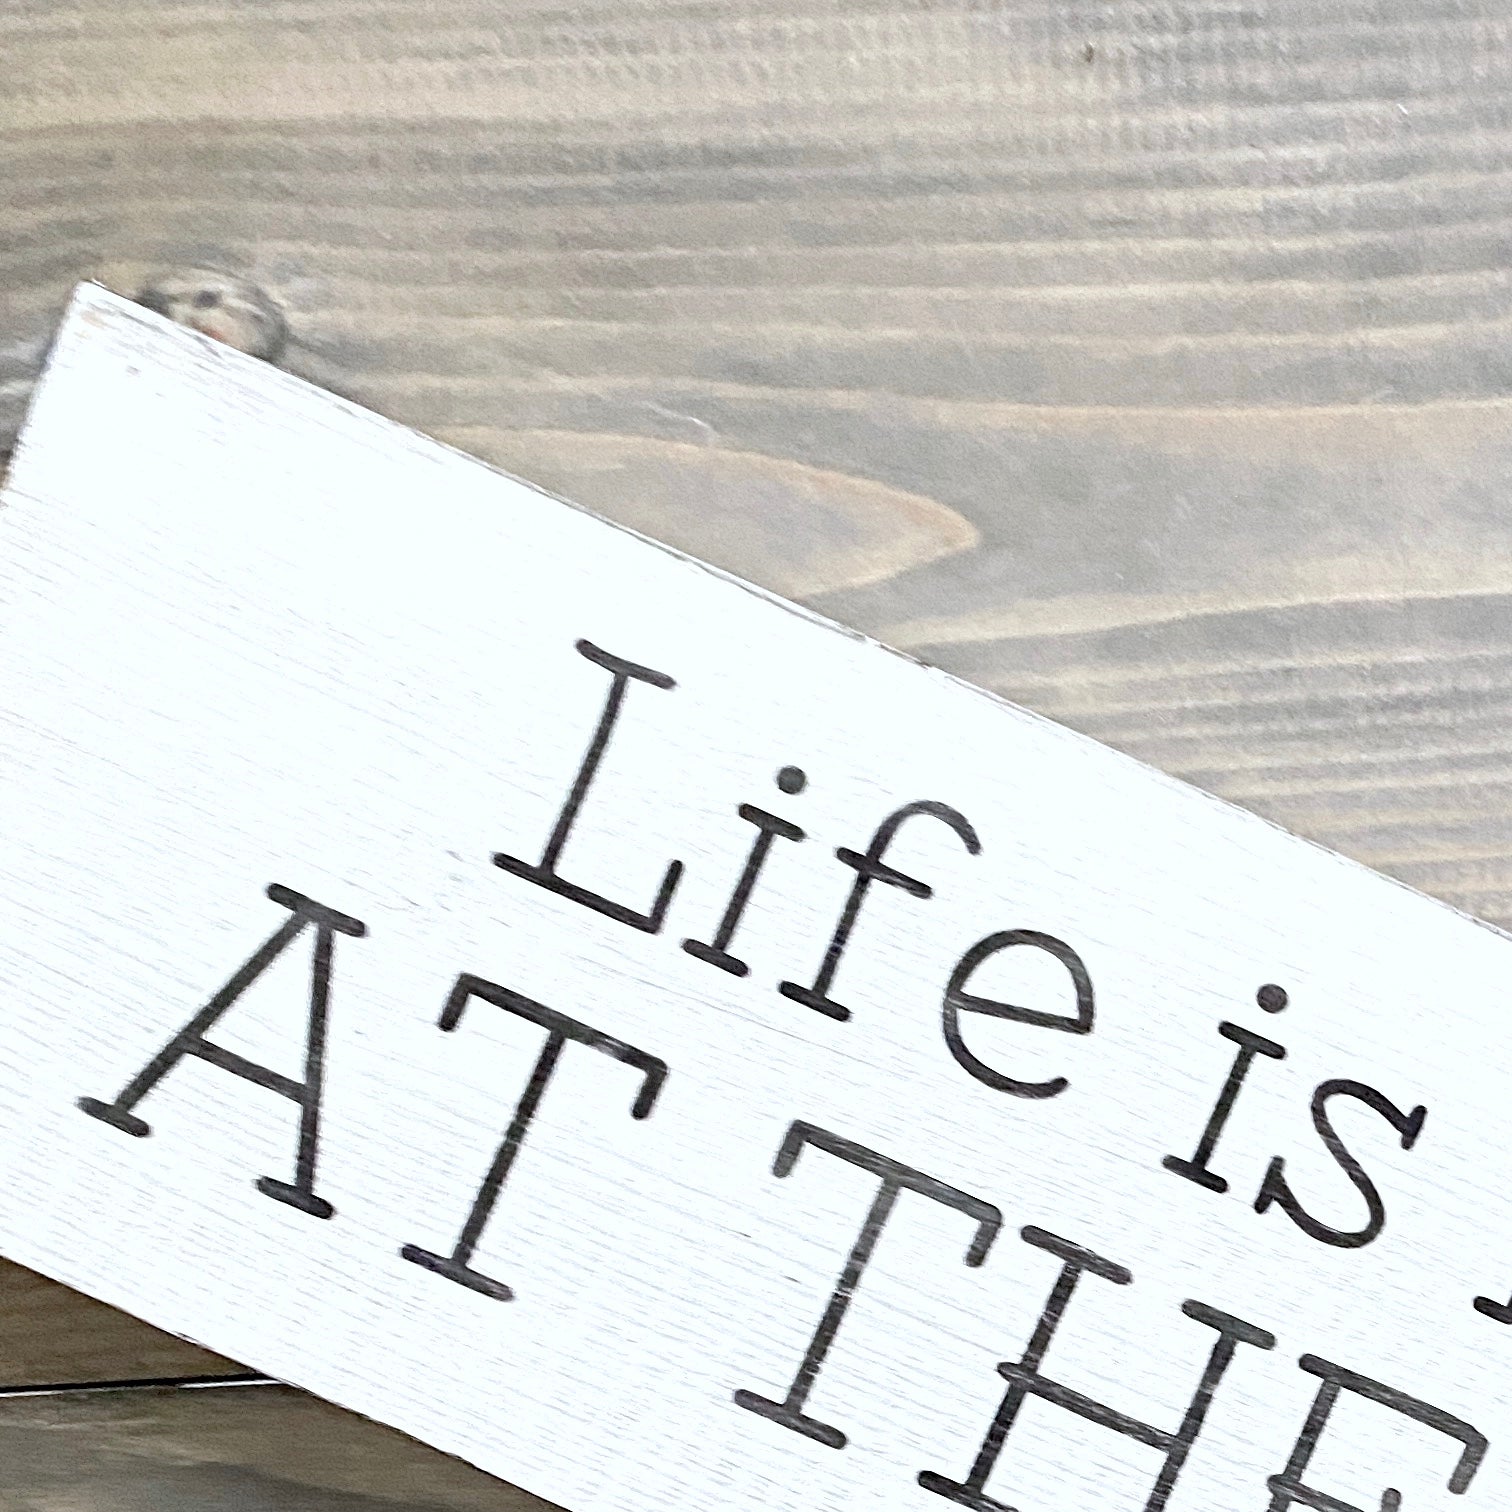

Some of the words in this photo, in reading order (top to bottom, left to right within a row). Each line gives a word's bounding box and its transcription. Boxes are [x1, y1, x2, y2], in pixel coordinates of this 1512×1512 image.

[77, 883, 668, 1301] AT
[492, 639, 1094, 1099] Life
[1162, 984, 1428, 1249] is
